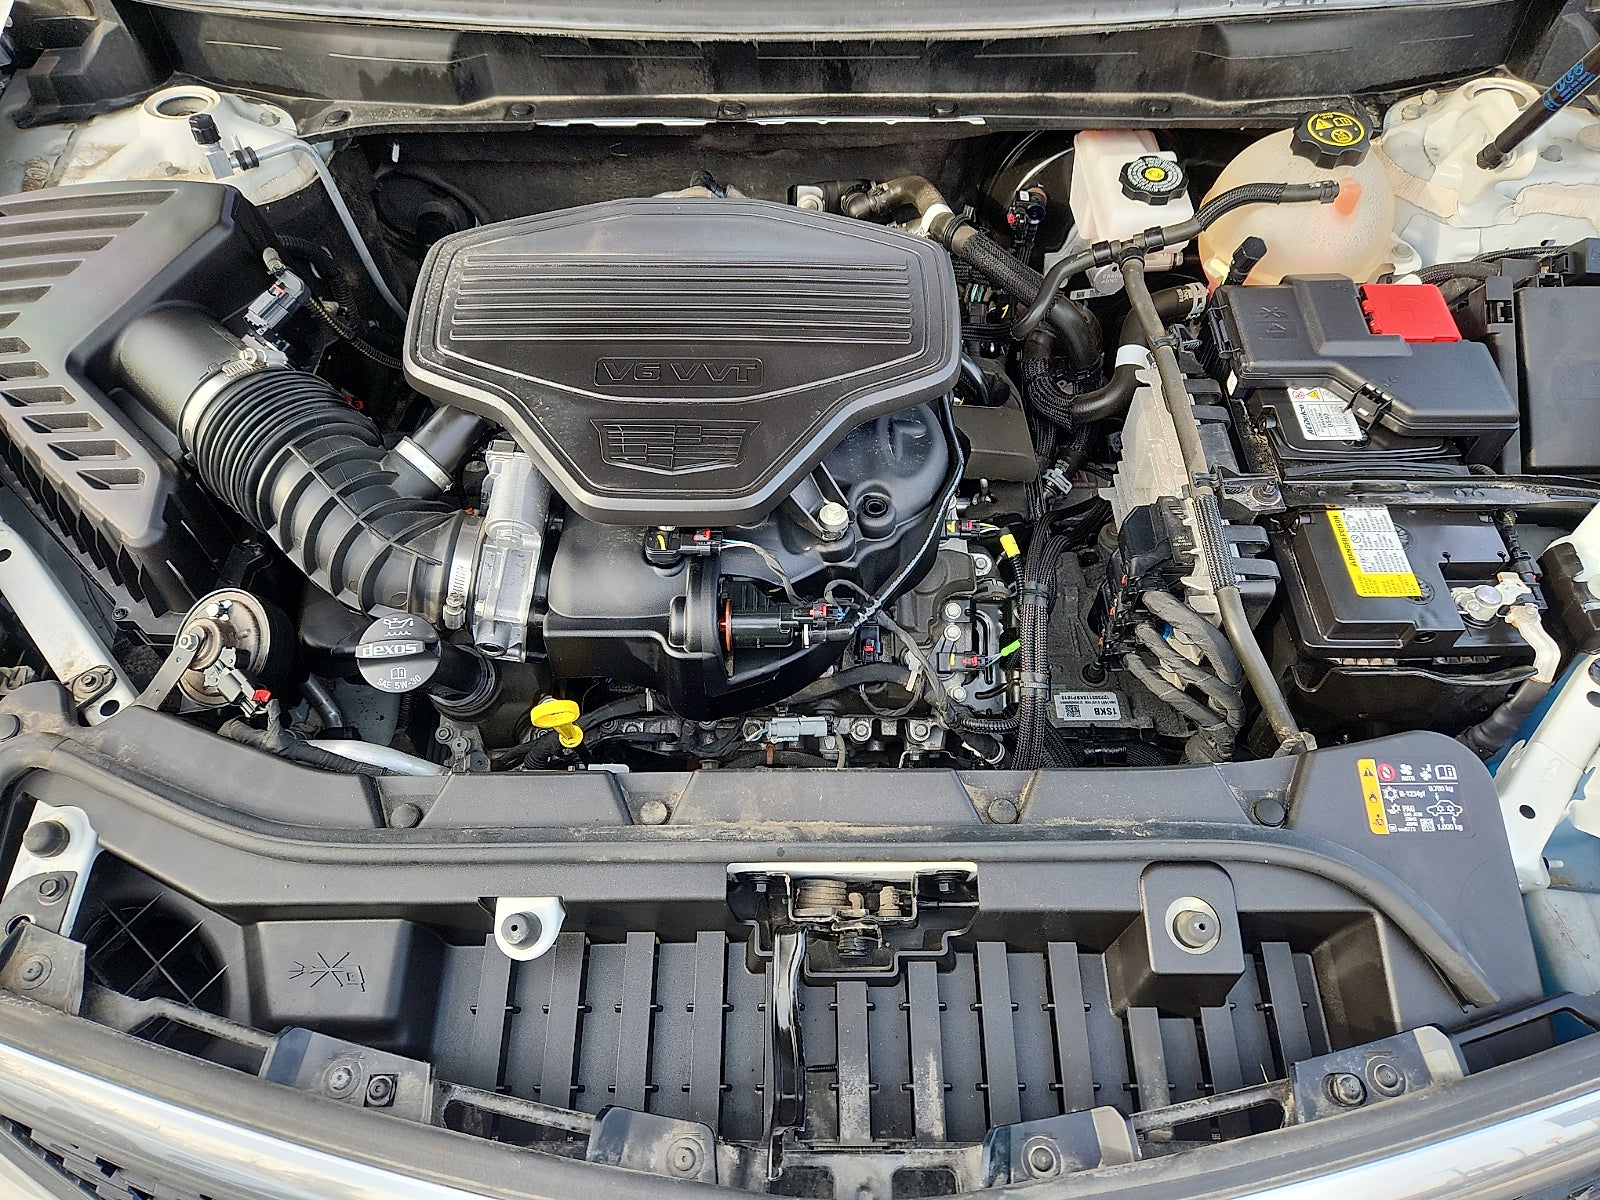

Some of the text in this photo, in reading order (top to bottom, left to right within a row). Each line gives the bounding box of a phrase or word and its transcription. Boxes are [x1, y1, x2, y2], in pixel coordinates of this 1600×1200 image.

[603, 362, 757, 382] V6 VVT
[362, 643, 419, 657] dexos
[377, 674, 422, 690] SAE 5W-30
[1093, 707, 1118, 716] 1SKB
